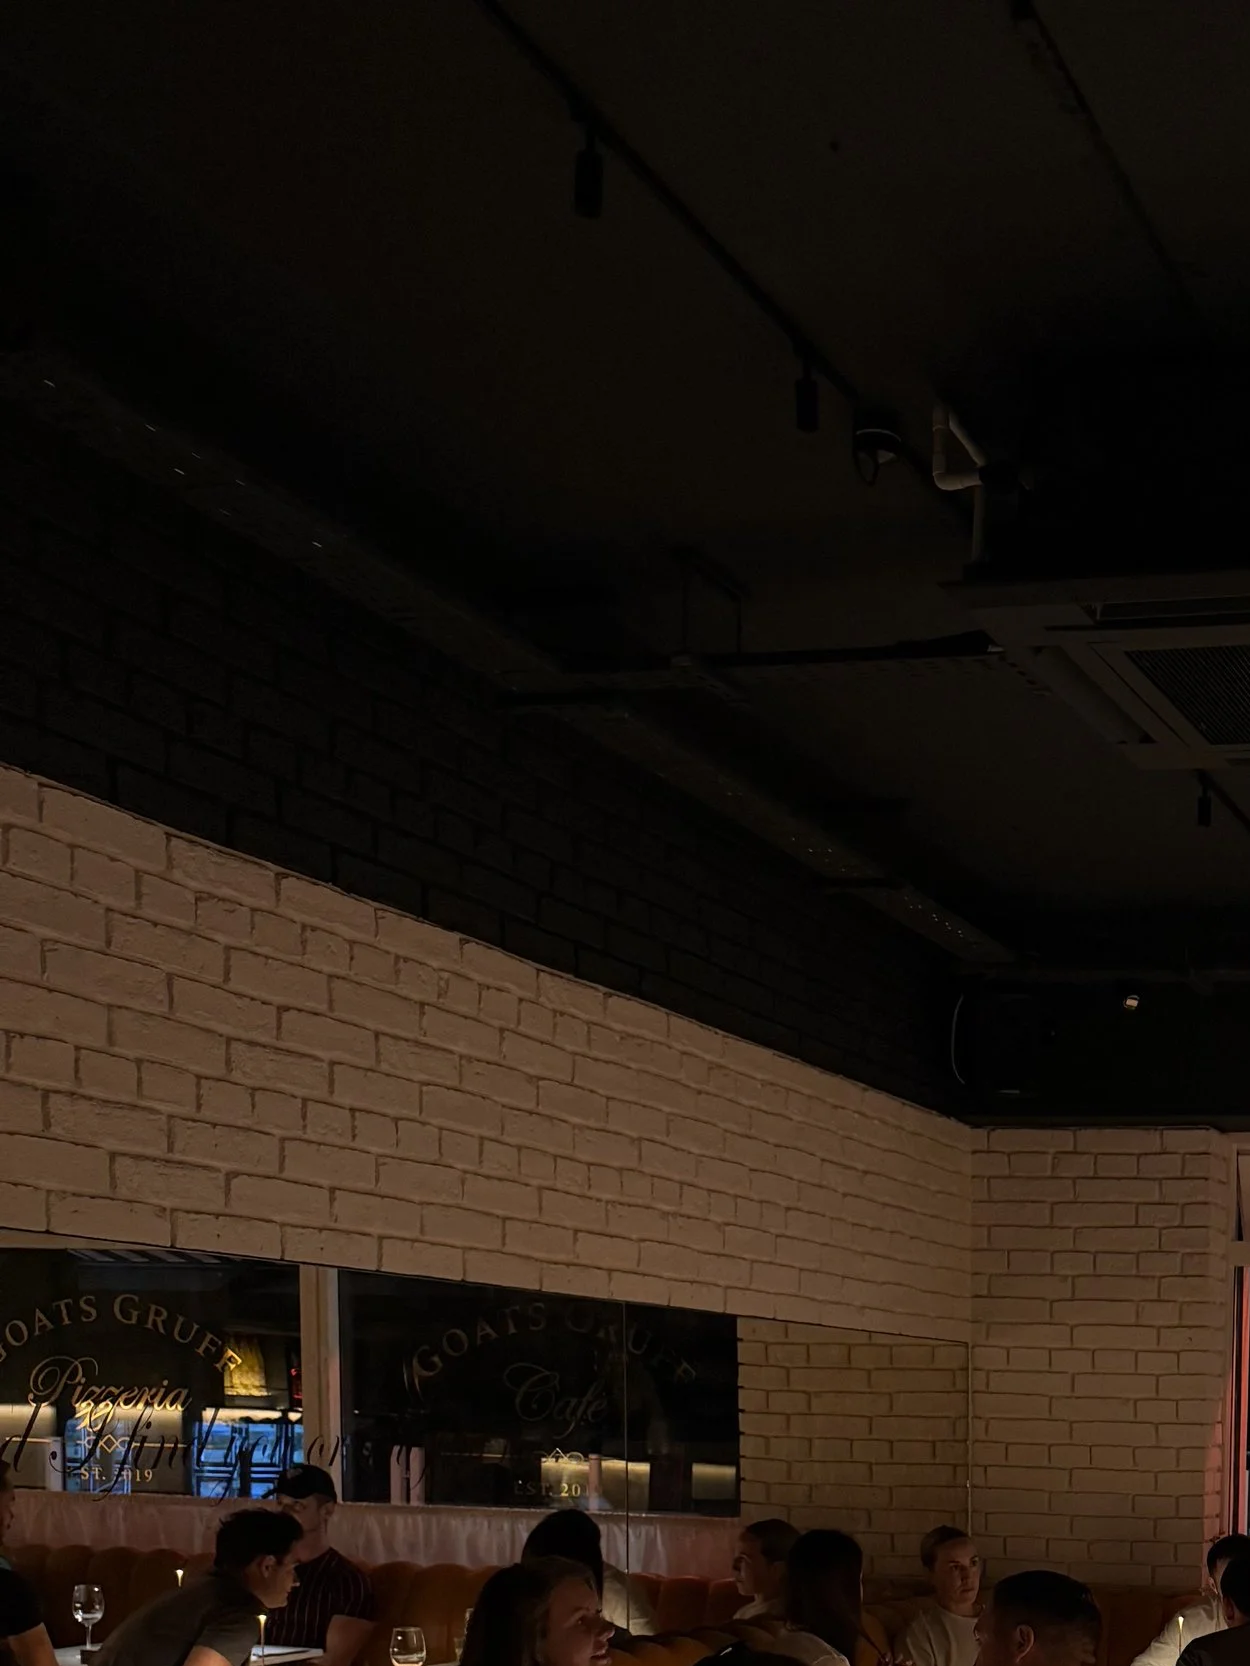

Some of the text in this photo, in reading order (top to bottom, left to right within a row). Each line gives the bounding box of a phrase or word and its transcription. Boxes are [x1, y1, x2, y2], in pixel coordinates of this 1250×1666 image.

[113, 1294, 242, 1373] GRUFF
[412, 1302, 546, 1379] GOATS
[27, 1355, 193, 1430] Pizzeria
